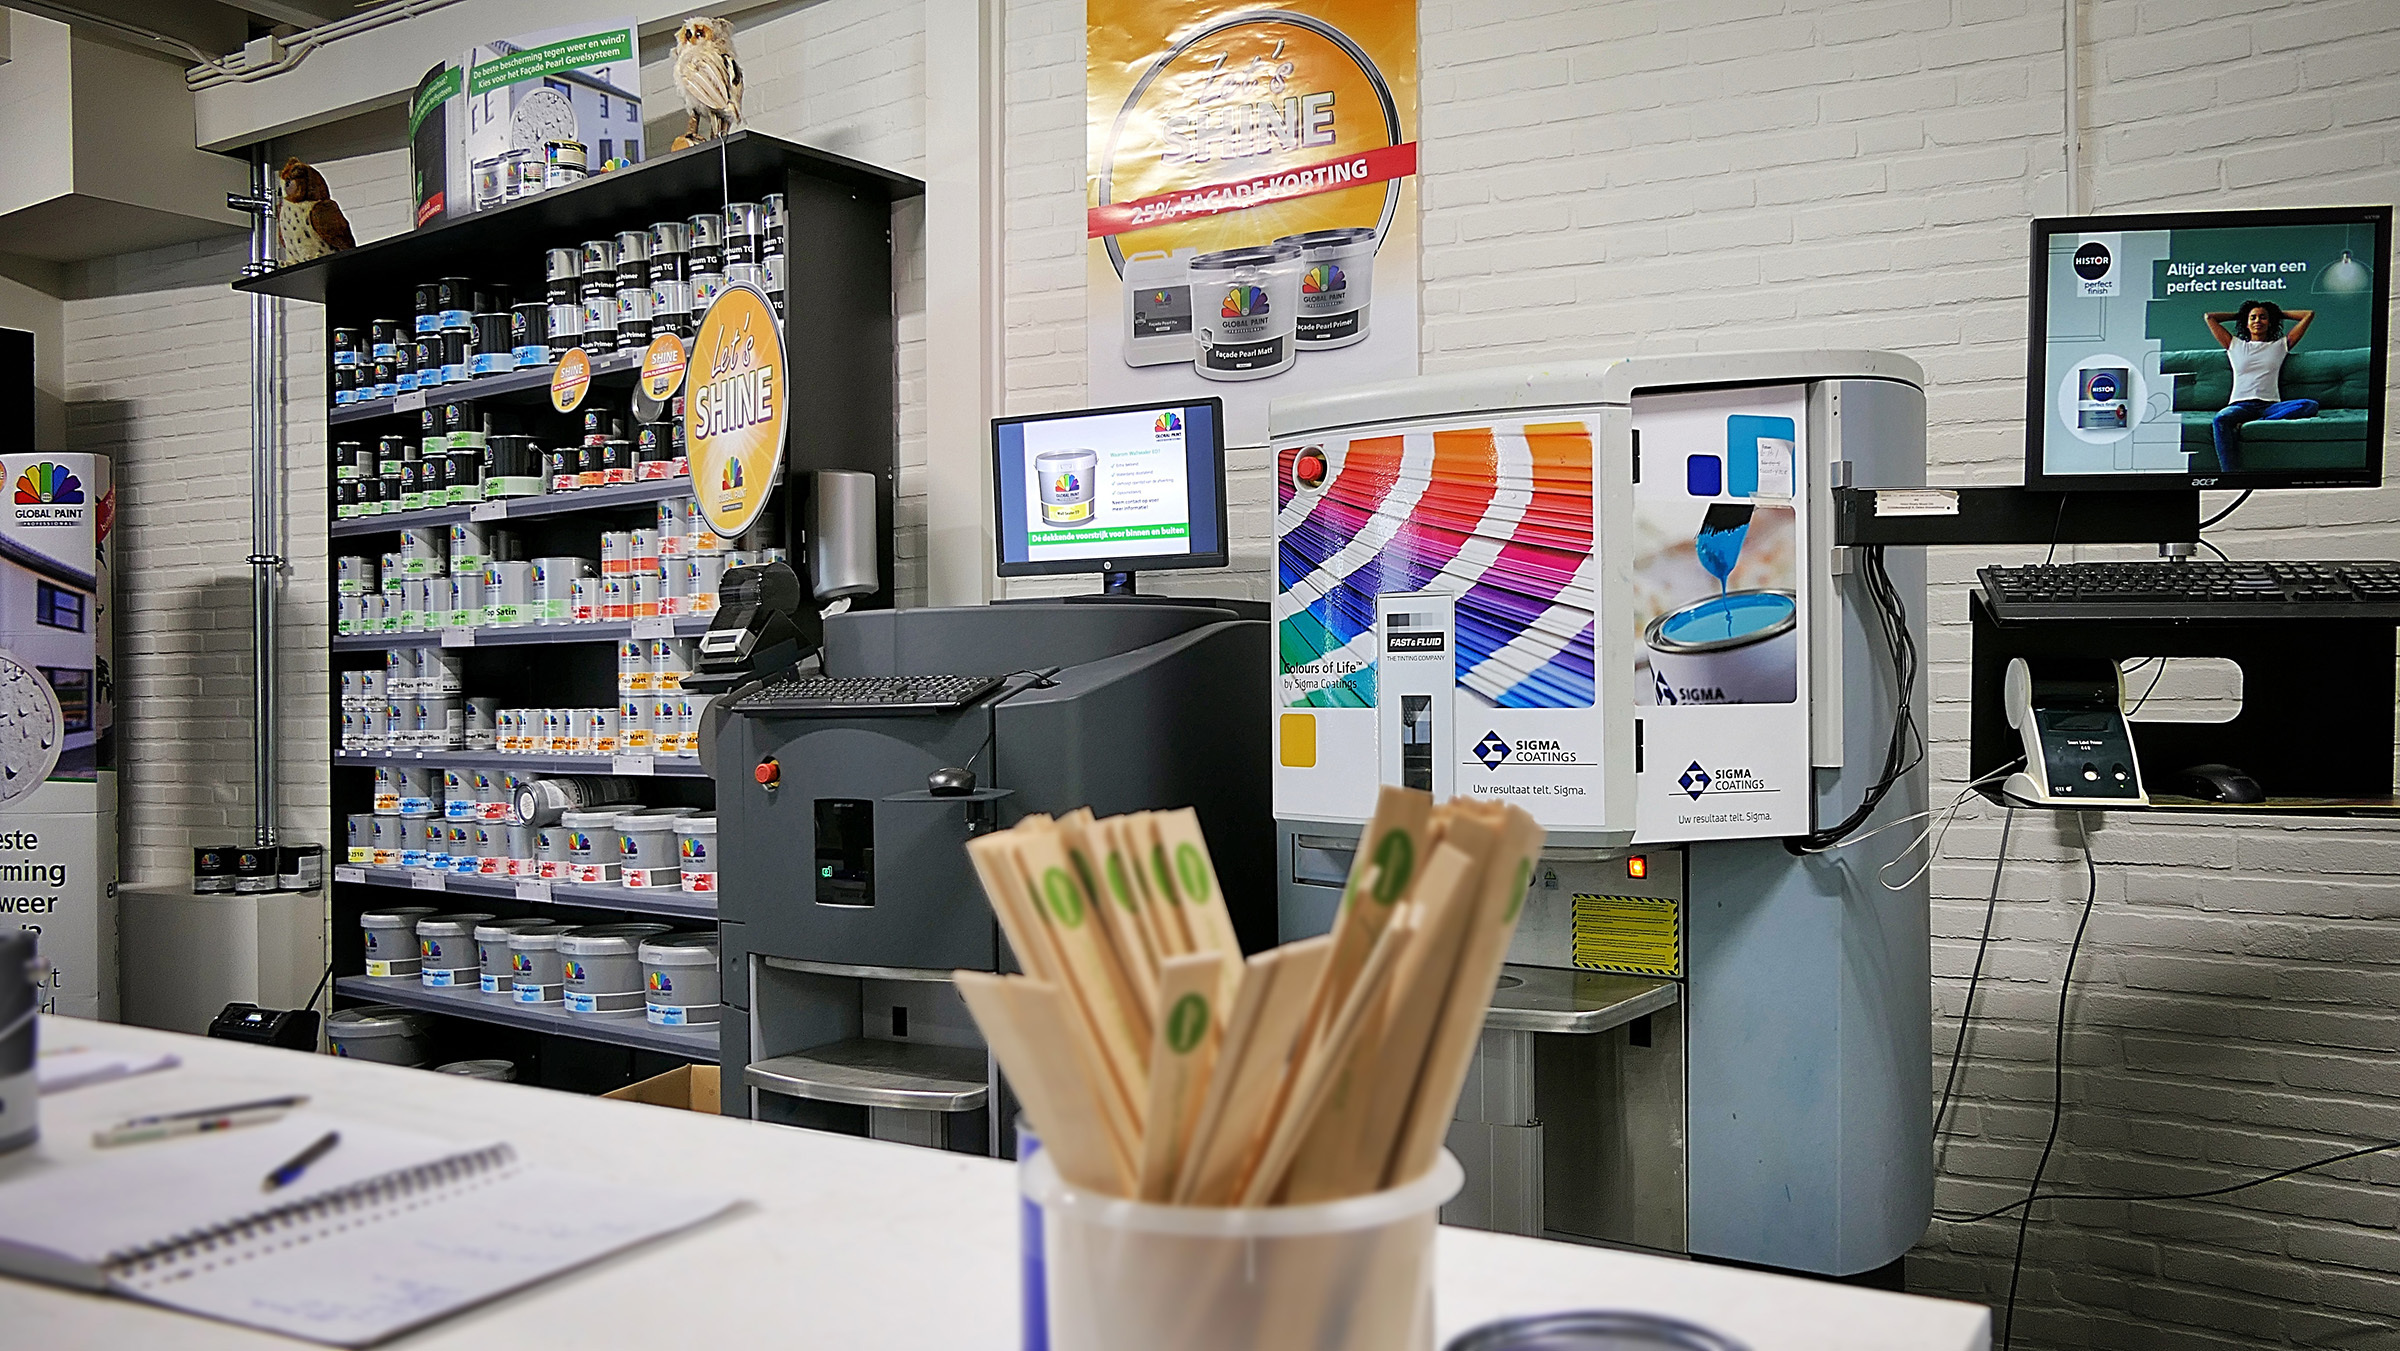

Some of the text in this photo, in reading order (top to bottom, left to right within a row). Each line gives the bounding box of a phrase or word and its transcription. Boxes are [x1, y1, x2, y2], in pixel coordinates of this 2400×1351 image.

[473, 34, 626, 79] De beste bescherming tegen weer en wind?
[478, 47, 620, 89] Kies voor het Façade Pearl Gevelsysteem
[1161, 90, 1336, 166] SHINE
[1131, 199, 1176, 225] 25%
[1269, 158, 1369, 192] KORTING
[2075, 256, 2109, 265] HISTOR
[2166, 262, 2307, 279] Altijd zeker van een
[2084, 280, 2112, 290] perfect
[2166, 277, 2286, 296] perfect resultaat.
[1328, 292, 1346, 300] PAINT
[2087, 288, 2108, 296] finish
[1222, 317, 1268, 328] GLOBAL PAINT
[1316, 322, 1332, 330] Pearl
[1333, 318, 1353, 329] Primer
[711, 311, 754, 379] Let's
[651, 350, 678, 365] SHINE
[1215, 346, 1273, 360] Façade Pearl Matt
[560, 363, 584, 379] SHINE
[695, 364, 773, 440] SHINE
[2191, 477, 2218, 486] acer
[15, 509, 84, 518] GLOBAL PAINT
[1042, 531, 1075, 542] dekkende
[1076, 529, 1108, 540] voorstrijk
[1108, 530, 1125, 538] voor
[1126, 528, 1150, 537] binnen
[1151, 528, 1160, 536] en
[1160, 526, 1185, 535] buiten
[496, 608, 517, 616] Satin
[1416, 637, 1442, 647] FLUID
[1284, 662, 1320, 674] Colours
[1322, 661, 1334, 674] of
[1284, 678, 1358, 690] by Sigma Coatings
[1680, 688, 1725, 700] SIGMA
[1516, 740, 1560, 751] SIGMA
[1516, 751, 1577, 763] COATINGS
[1715, 769, 1752, 780] SIGMA
[1472, 784, 1587, 798] Uw resultaat telt. Sigma.
[1715, 779, 1765, 791] COATINGS
[1678, 812, 1772, 825] Uw resultaat telt. Sigma.
